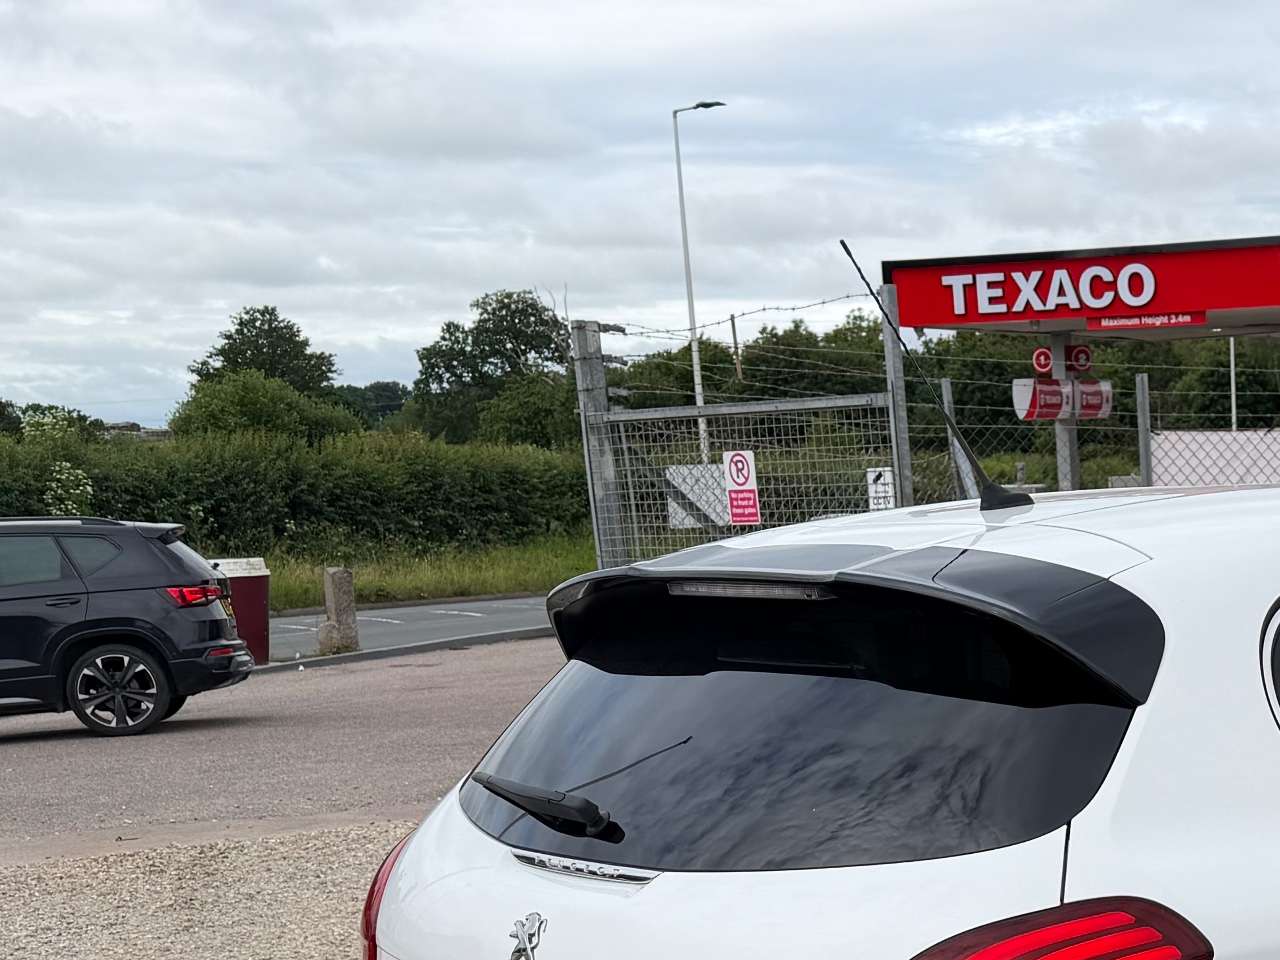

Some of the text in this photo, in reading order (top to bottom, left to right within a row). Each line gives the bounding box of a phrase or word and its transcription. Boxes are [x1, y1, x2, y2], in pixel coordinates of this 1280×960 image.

[941, 263, 1156, 315] TEXACO
[1101, 314, 1191, 327] Maximum Height 3.4m
[1039, 354, 1046, 366] 1
